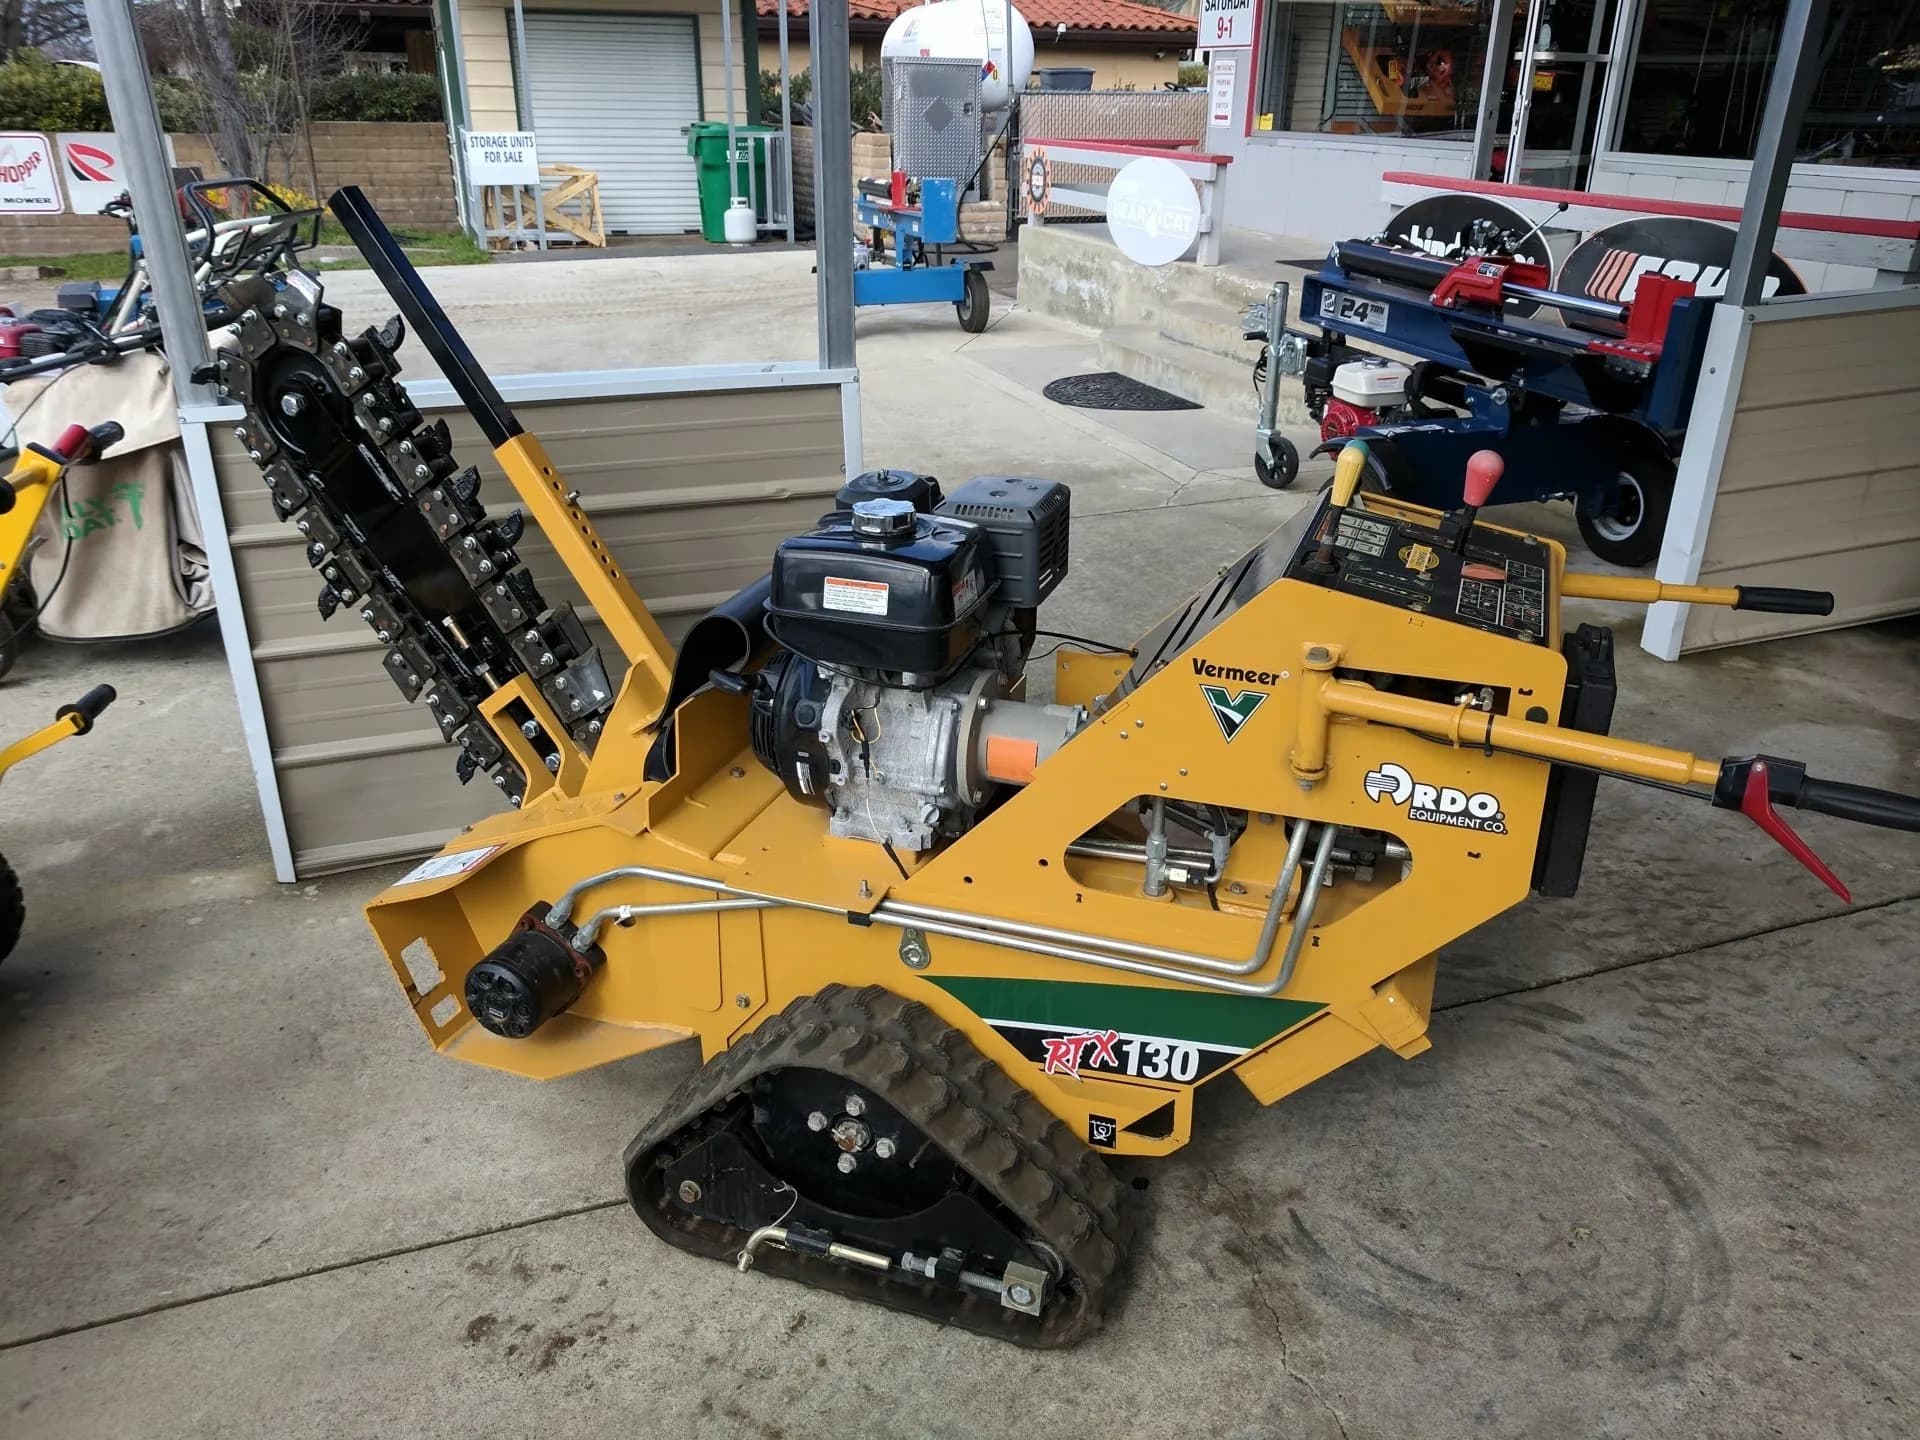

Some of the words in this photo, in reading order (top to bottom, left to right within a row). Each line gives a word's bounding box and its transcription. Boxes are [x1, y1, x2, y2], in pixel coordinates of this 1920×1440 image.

[1205, 0, 1251, 11] SATURDAY
[1217, 16, 1234, 39] 9-1
[470, 135, 508, 148] STORAGE
[510, 136, 534, 148] UNITS
[484, 151, 501, 163] FOR
[503, 151, 523, 163] SALE
[1340, 297, 1370, 322] 24
[1192, 658, 1279, 686] Vermeer
[1409, 809, 1482, 830] EQUIPMENT
[1483, 820, 1507, 834] CO.
[1042, 1030, 1120, 1082] RTX
[1122, 1040, 1200, 1081] 130
